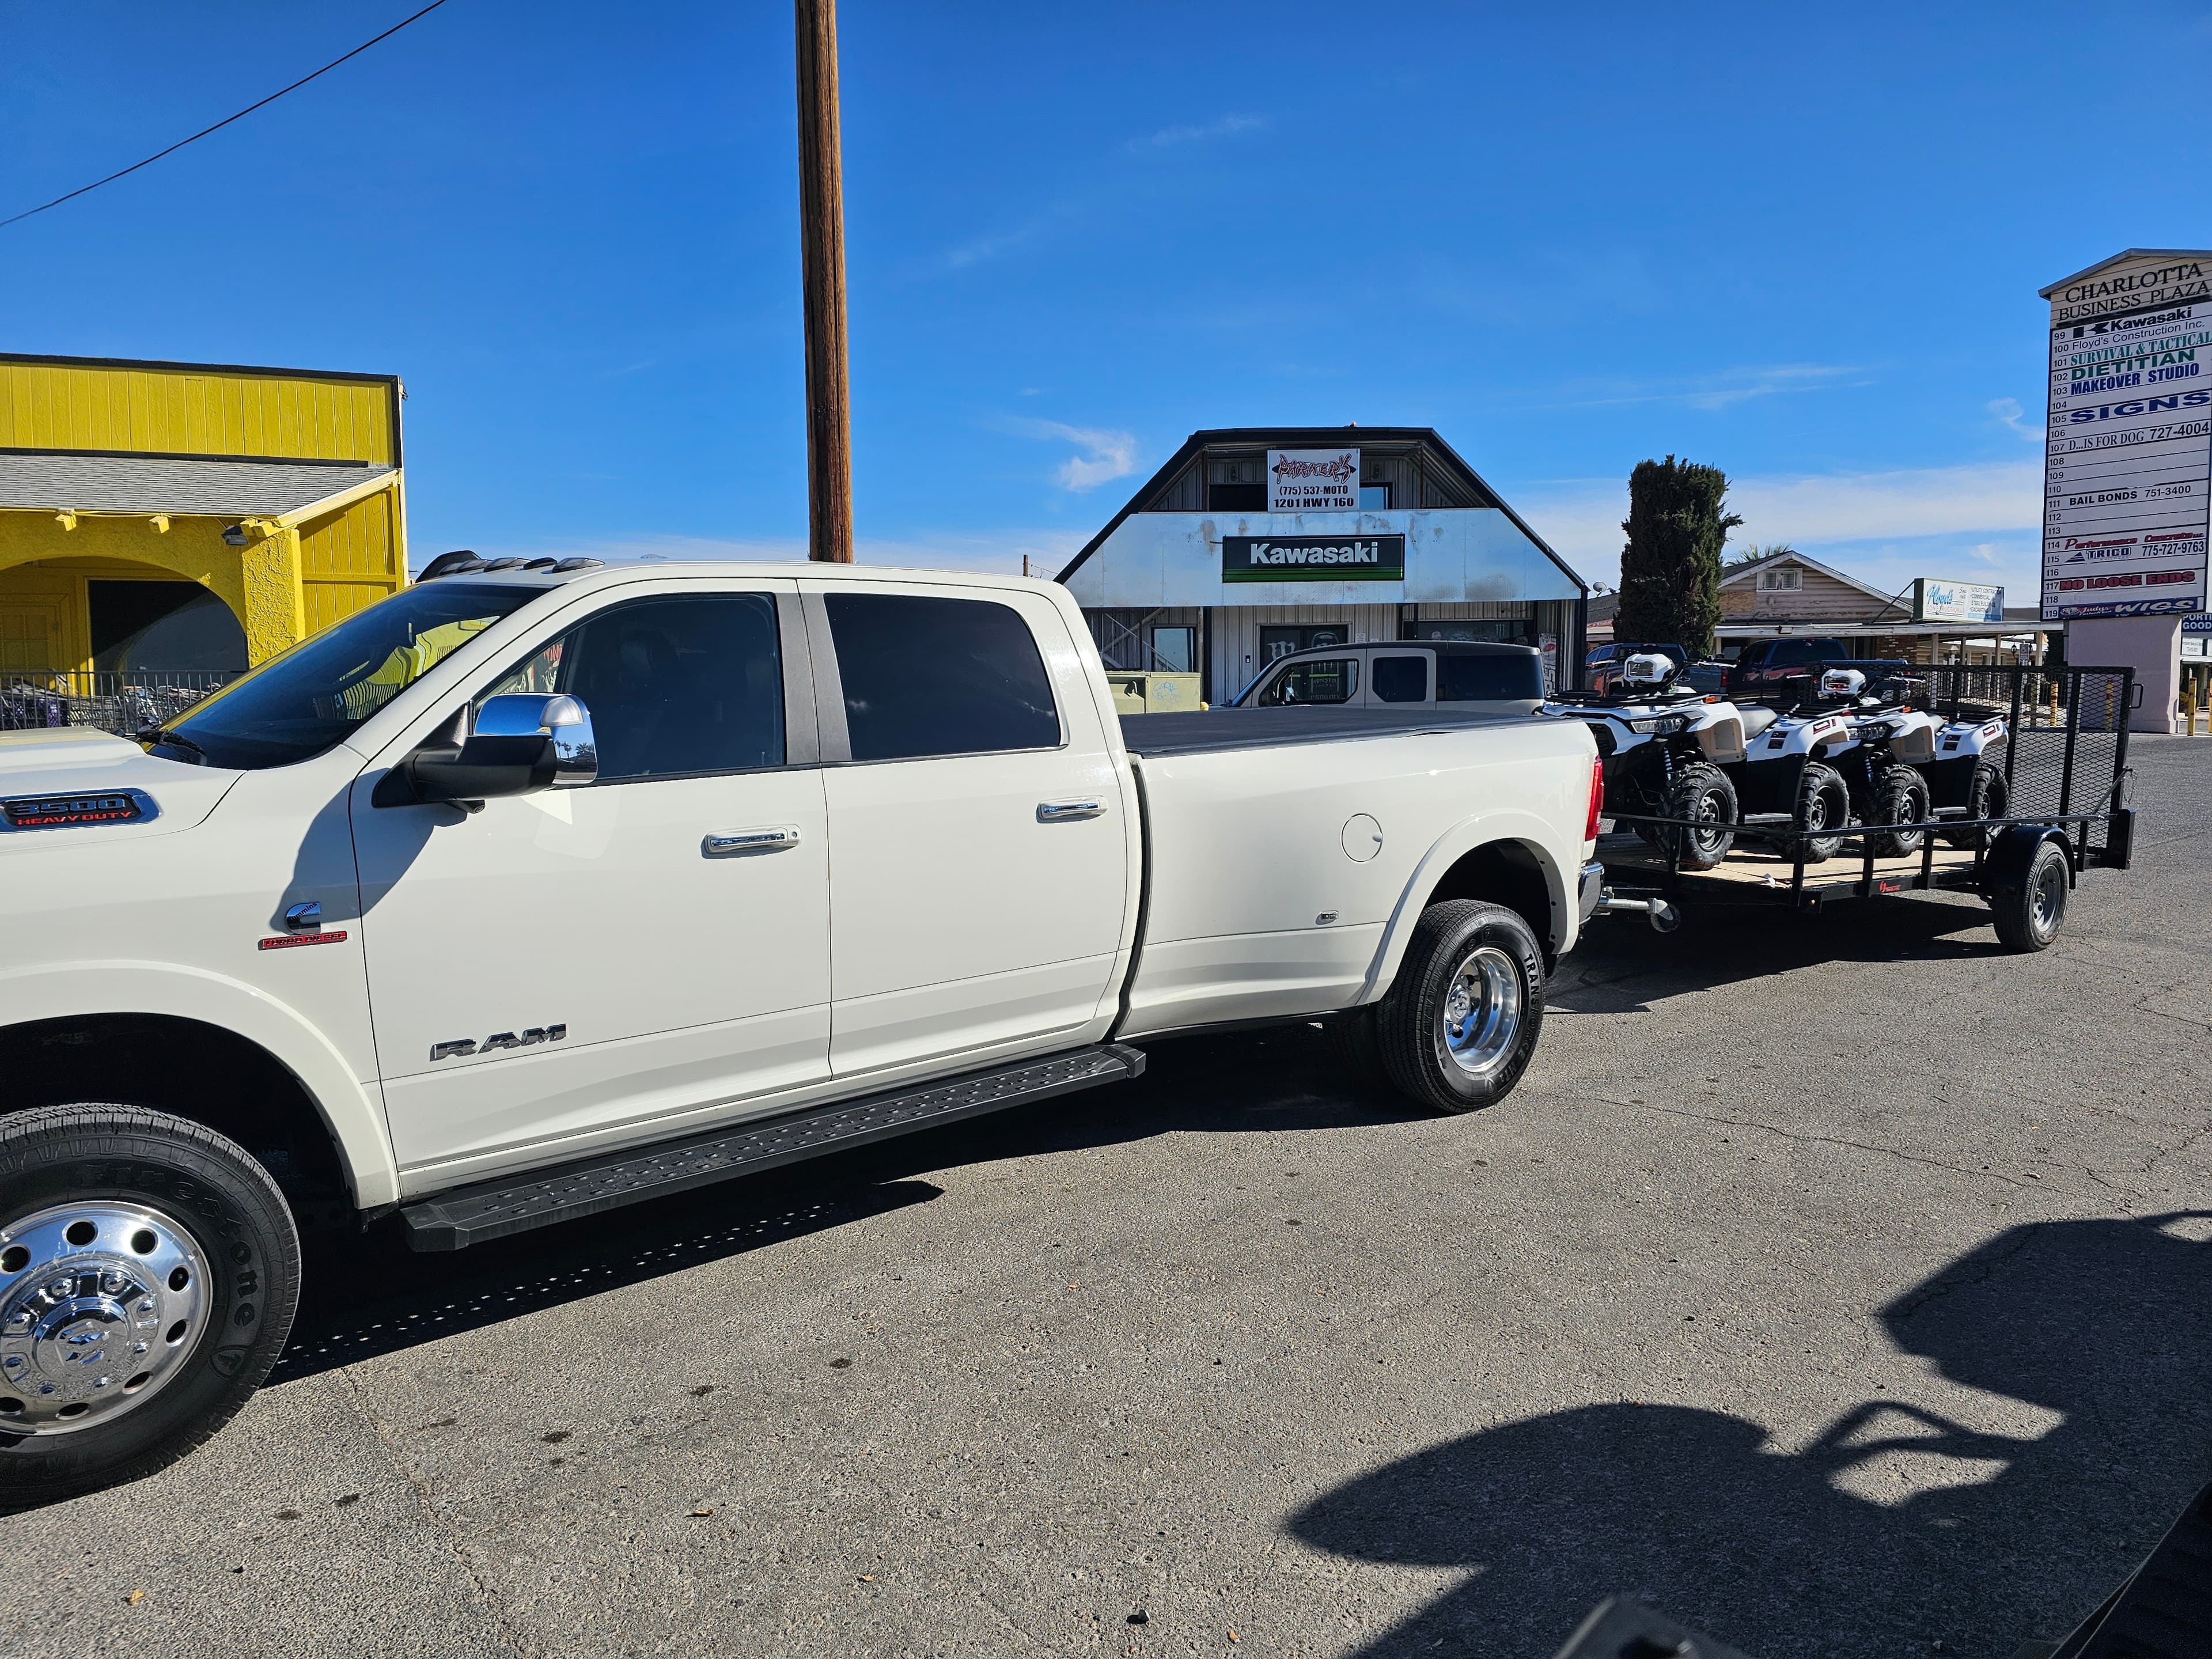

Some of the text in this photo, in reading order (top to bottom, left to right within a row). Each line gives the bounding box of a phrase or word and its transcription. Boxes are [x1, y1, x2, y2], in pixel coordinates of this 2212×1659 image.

[2065, 262, 2204, 303] CHARLOTTA
[2059, 280, 2210, 321] BUSINESS PLAZA
[2054, 306, 2192, 340] 99 Kawasaki
[2054, 320, 2205, 354] 100 Floyd's Construction Inc.
[2054, 331, 2211, 368] 101 SURVIVAL & TACTICAL
[2053, 349, 2195, 382] 102 DIETITIAN
[2052, 362, 2200, 396] 103 MAKEOVER STUDIO
[2051, 392, 2211, 423] 105 SIGNS
[2052, 401, 2067, 410] 104
[2050, 444, 2065, 452] 107
[2096, 434, 2118, 447] FOR
[2120, 431, 2145, 444] DOG
[2149, 421, 2210, 440] 727-4004
[2051, 429, 2066, 438] 106
[1277, 453, 1352, 484] PARKER'S
[2049, 457, 2065, 466] 108
[2049, 472, 2064, 480] 109
[1279, 485, 1349, 496] (775) 537-MOTO
[2048, 486, 2061, 494] 110
[2048, 485, 2191, 508] 111 BAIL BONDS 751-3400
[1274, 497, 1354, 508] 1201 HWY 160
[2048, 513, 2061, 521] 112
[1250, 541, 1378, 565] Kawasaki
[2047, 540, 2061, 549] 114
[2065, 537, 2138, 550] Performance
[2086, 540, 2205, 559] TRICO 775-727-9763
[2047, 555, 2059, 563] 115
[2046, 571, 2196, 591] 117 NO LOOSE ENDS
[2045, 609, 2058, 618] 119
[2115, 600, 2194, 613] WIGS
[2046, 596, 2058, 604] 118
[12, 797, 126, 816] 3500
[17, 811, 132, 825] HEAVY DUTY
[430, 1023, 566, 1062] RAM
